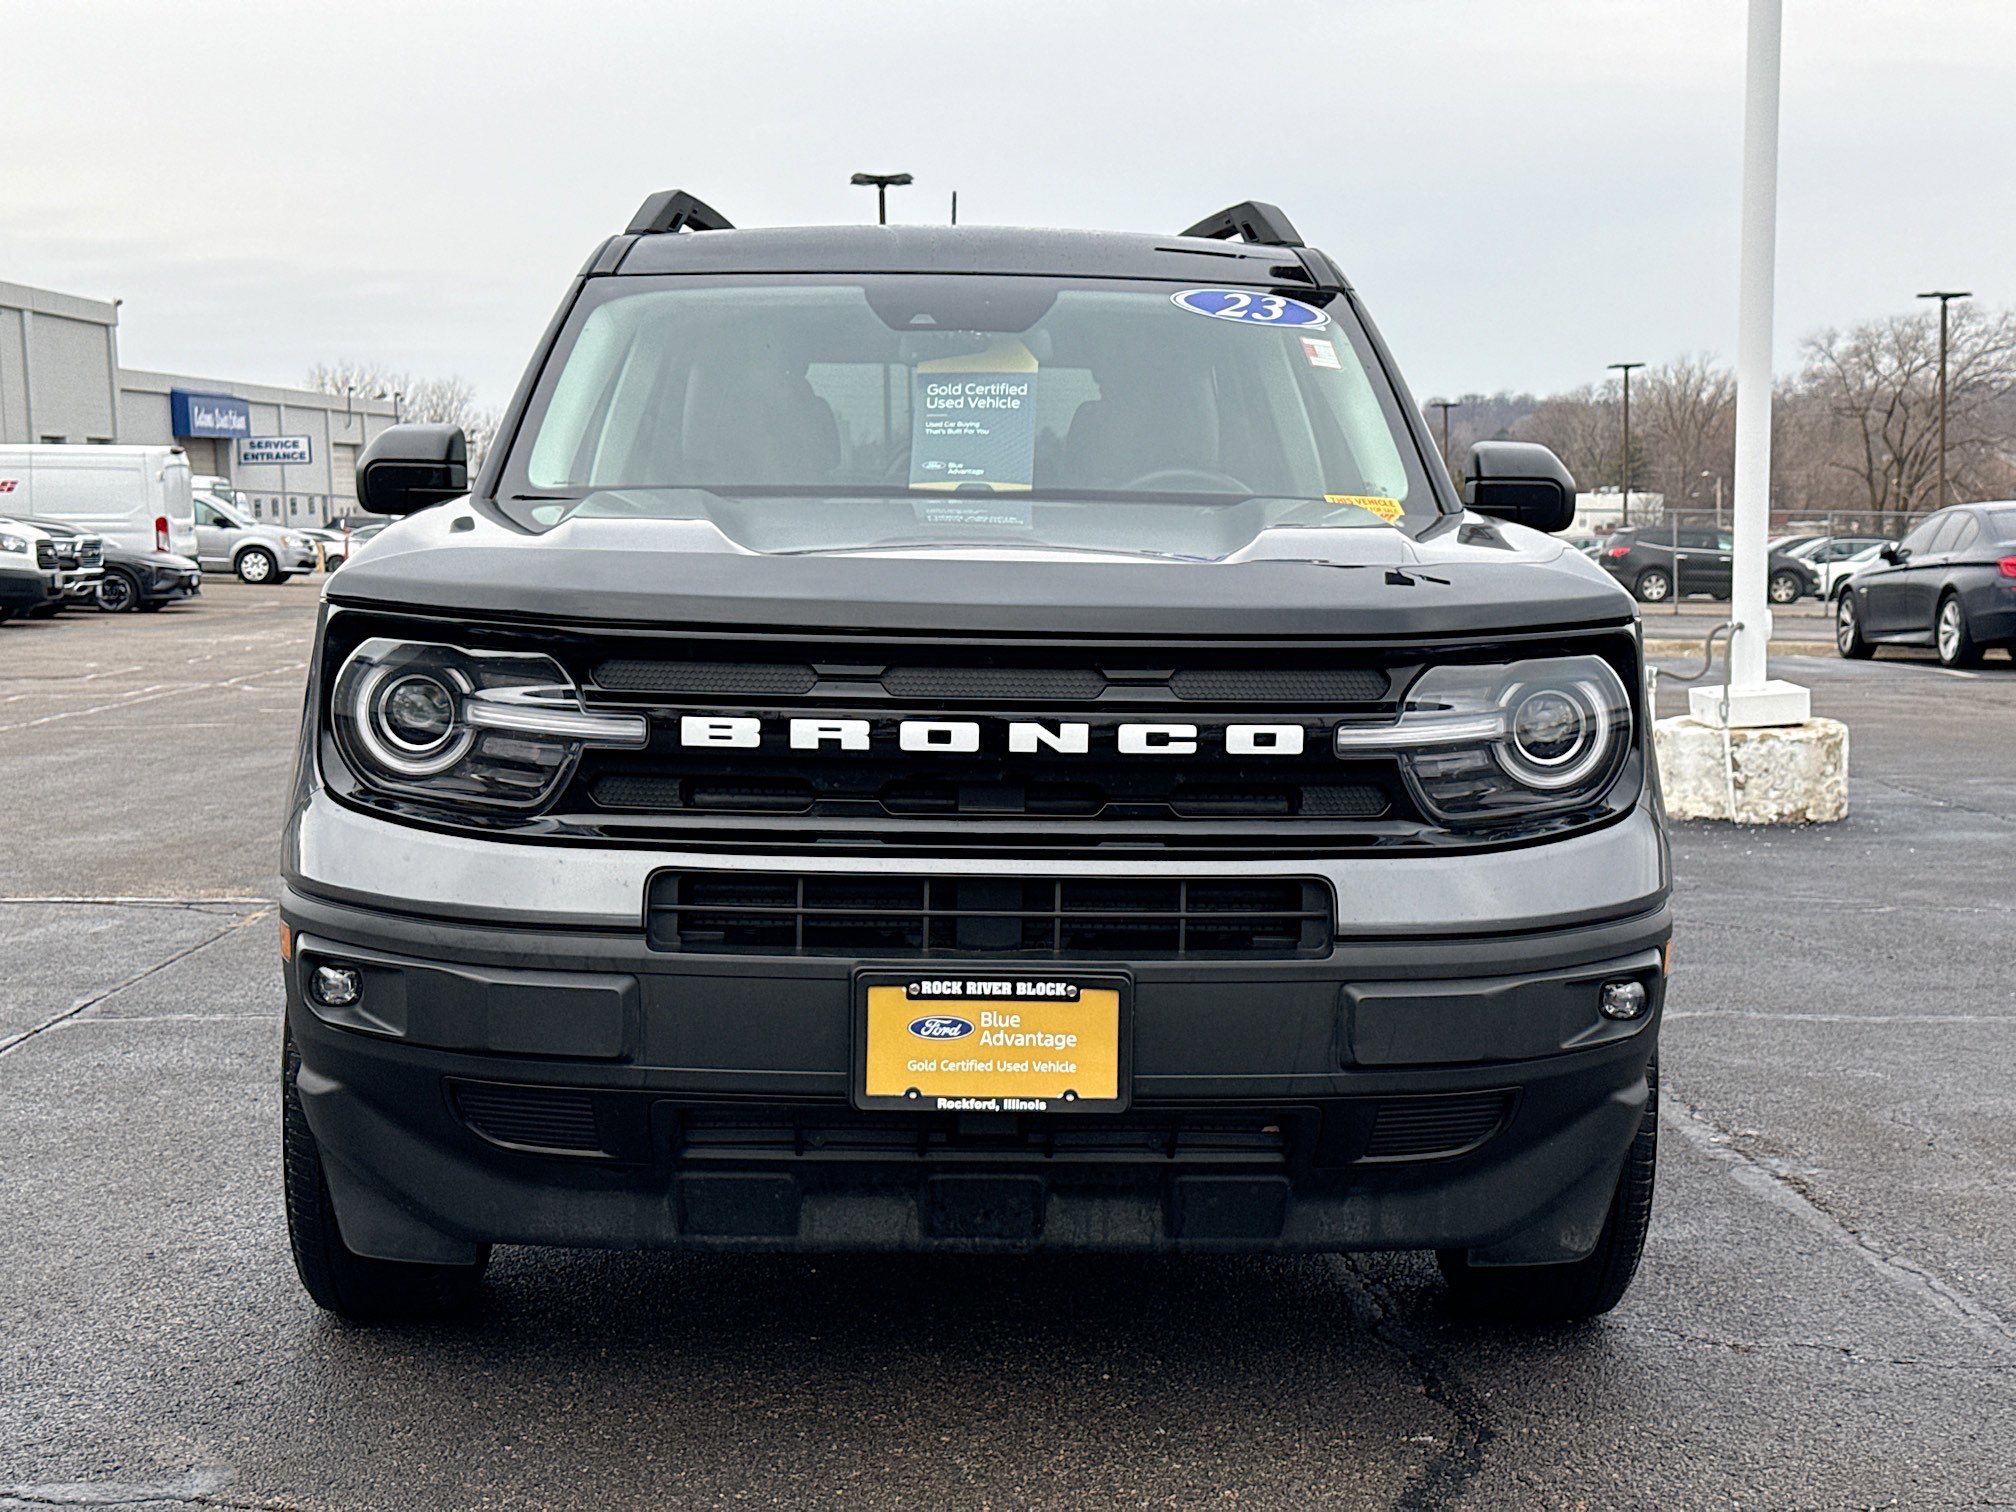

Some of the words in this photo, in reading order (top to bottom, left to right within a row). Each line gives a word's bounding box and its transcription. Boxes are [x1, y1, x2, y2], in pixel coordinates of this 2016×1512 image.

[1216, 293, 1287, 321] 23
[926, 383, 962, 396] Gold
[964, 382, 1028, 396] Certified
[926, 396, 964, 409] Used
[968, 396, 1020, 409] Vehicle
[957, 420, 980, 429] Buying
[249, 440, 300, 450] SERVICE
[243, 451, 306, 461] ENTRANCE
[1330, 497, 1353, 505] THIS
[1354, 498, 1395, 508] VEHICLE
[680, 715, 1304, 755] BRONCO
[921, 981, 962, 995] ROCK
[966, 982, 1012, 996] RIVER
[1016, 982, 1067, 997] BLOCK
[980, 1011, 1020, 1028] Blue
[920, 1018, 962, 1037] Ford
[979, 1030, 1077, 1049] Advantage
[907, 1060, 937, 1071] Gold
[940, 1059, 992, 1072] Certified
[997, 1060, 1029, 1072] Used
[1032, 1061, 1077, 1073] Vehicle
[936, 1098, 1000, 1112] Rockford,
[1003, 1099, 1047, 1112] Illinois
